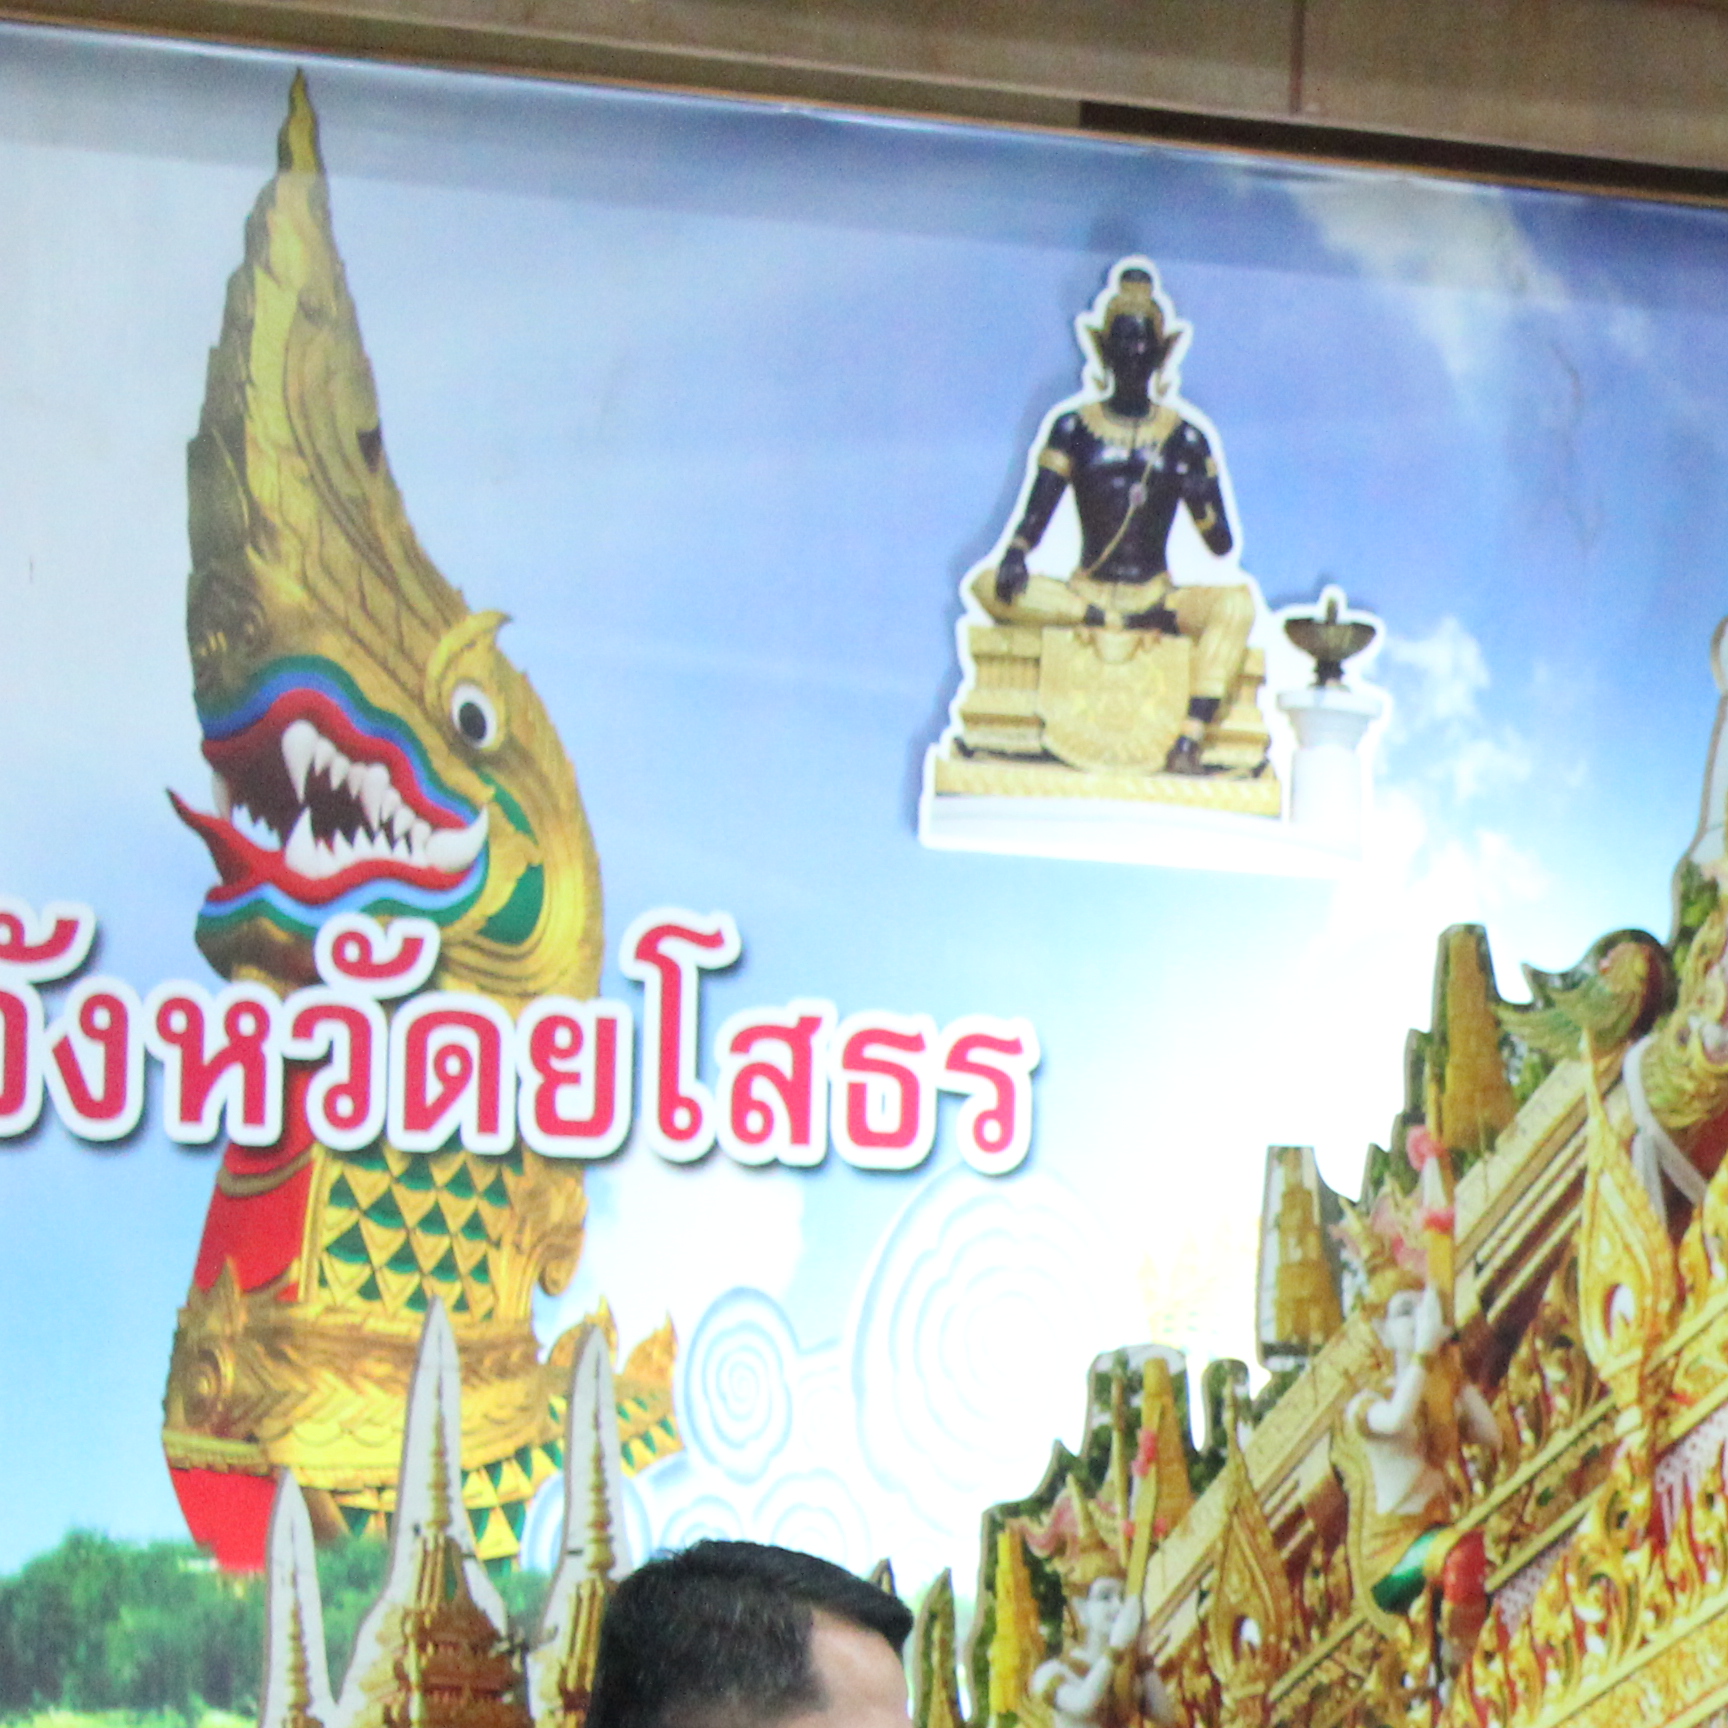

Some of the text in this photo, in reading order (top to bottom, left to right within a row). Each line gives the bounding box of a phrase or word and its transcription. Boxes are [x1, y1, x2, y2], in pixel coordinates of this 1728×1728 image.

[0, 910, 1024, 1155] ังหวัดยโสธร
